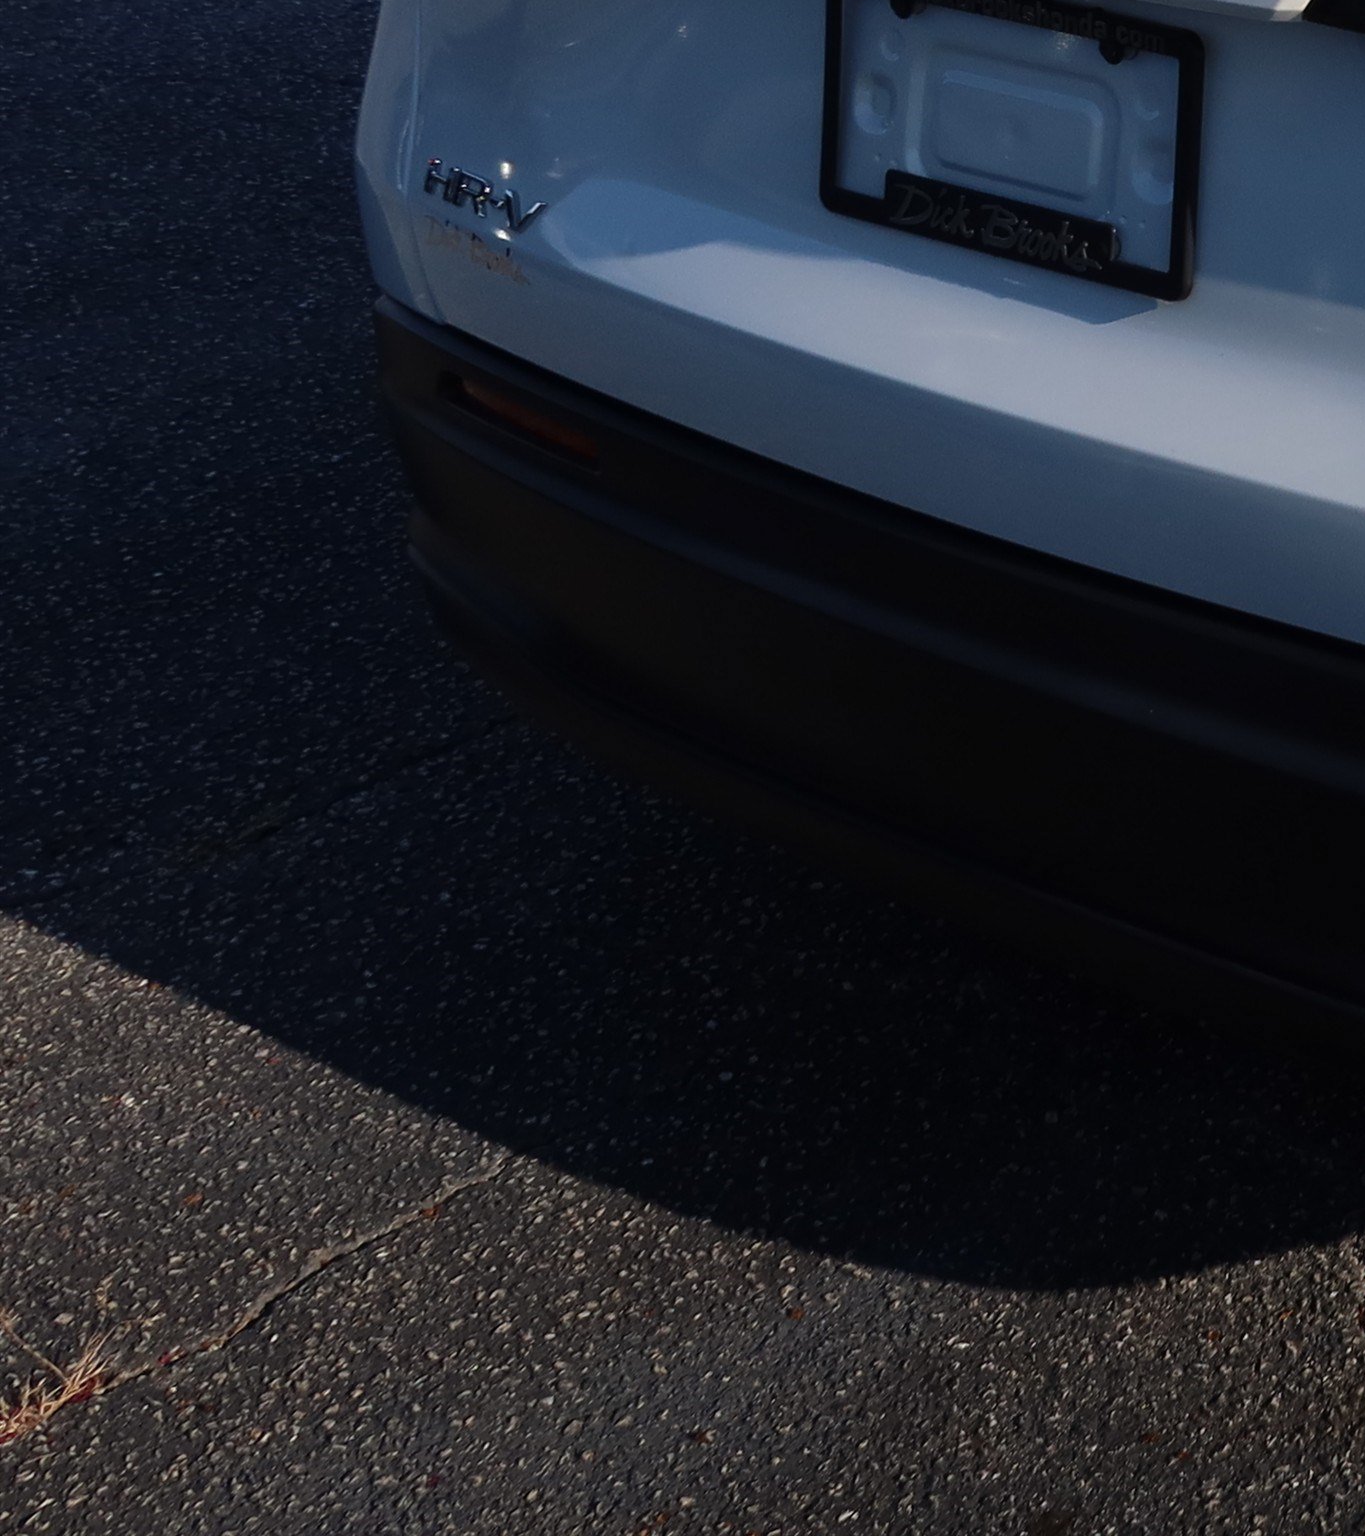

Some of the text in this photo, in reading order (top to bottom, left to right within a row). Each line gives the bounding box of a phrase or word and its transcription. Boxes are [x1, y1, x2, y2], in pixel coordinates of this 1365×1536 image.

[424, 157, 549, 234] HR-V
[888, 182, 1104, 274] Dick Brooks
